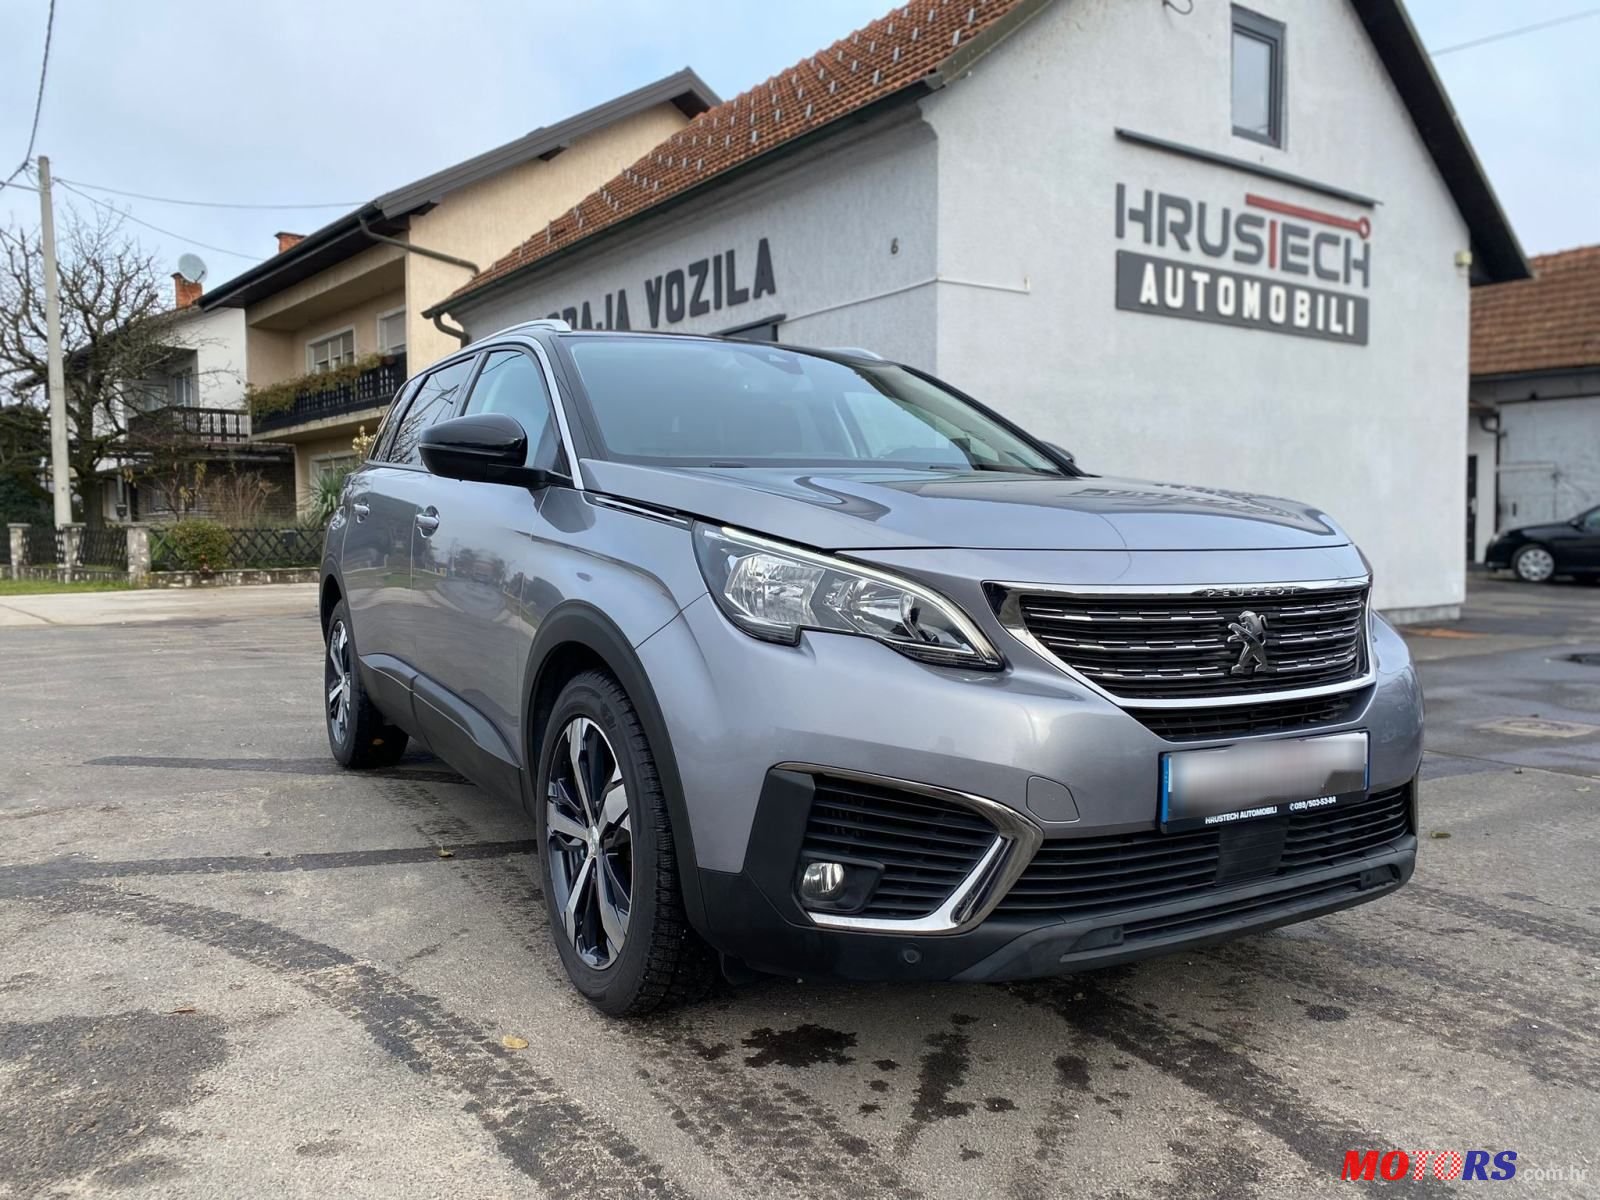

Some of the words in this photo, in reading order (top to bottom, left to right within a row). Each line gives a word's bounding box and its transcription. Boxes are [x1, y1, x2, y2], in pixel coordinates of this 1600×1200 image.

[890, 237, 899, 255] 6
[1115, 182, 1371, 288] HRUSTECH
[645, 237, 776, 328] VOZILA
[1139, 262, 1355, 335] AUTOMOBILI
[1207, 586, 1297, 598] PEUGEOT
[1240, 806, 1278, 819] AUTOMOBILI
